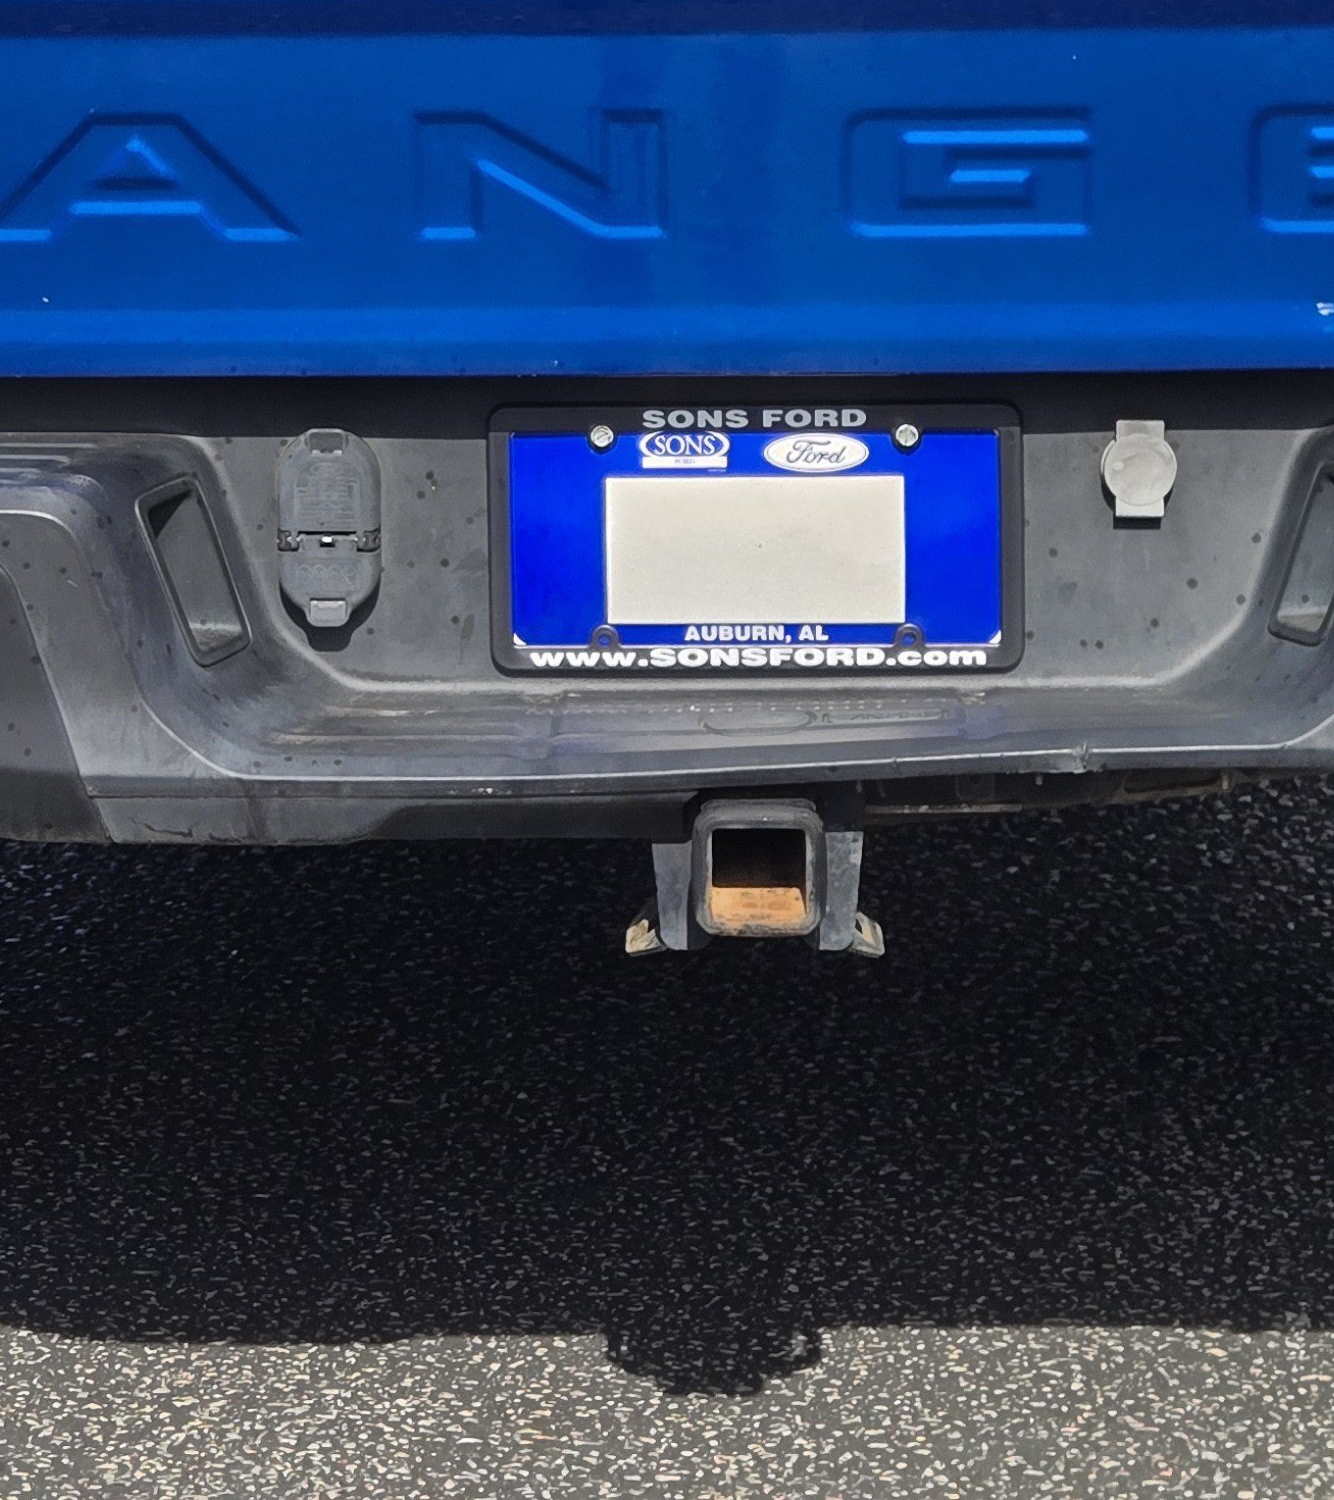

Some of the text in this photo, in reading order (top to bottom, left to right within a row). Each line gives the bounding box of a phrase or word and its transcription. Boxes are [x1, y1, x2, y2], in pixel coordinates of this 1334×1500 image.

[642, 408, 867, 429] SONS FORD
[653, 434, 847, 464] SONS Ford
[684, 625, 829, 643] AUBURN, AL
[529, 647, 988, 668] www.SONSFORD.com
